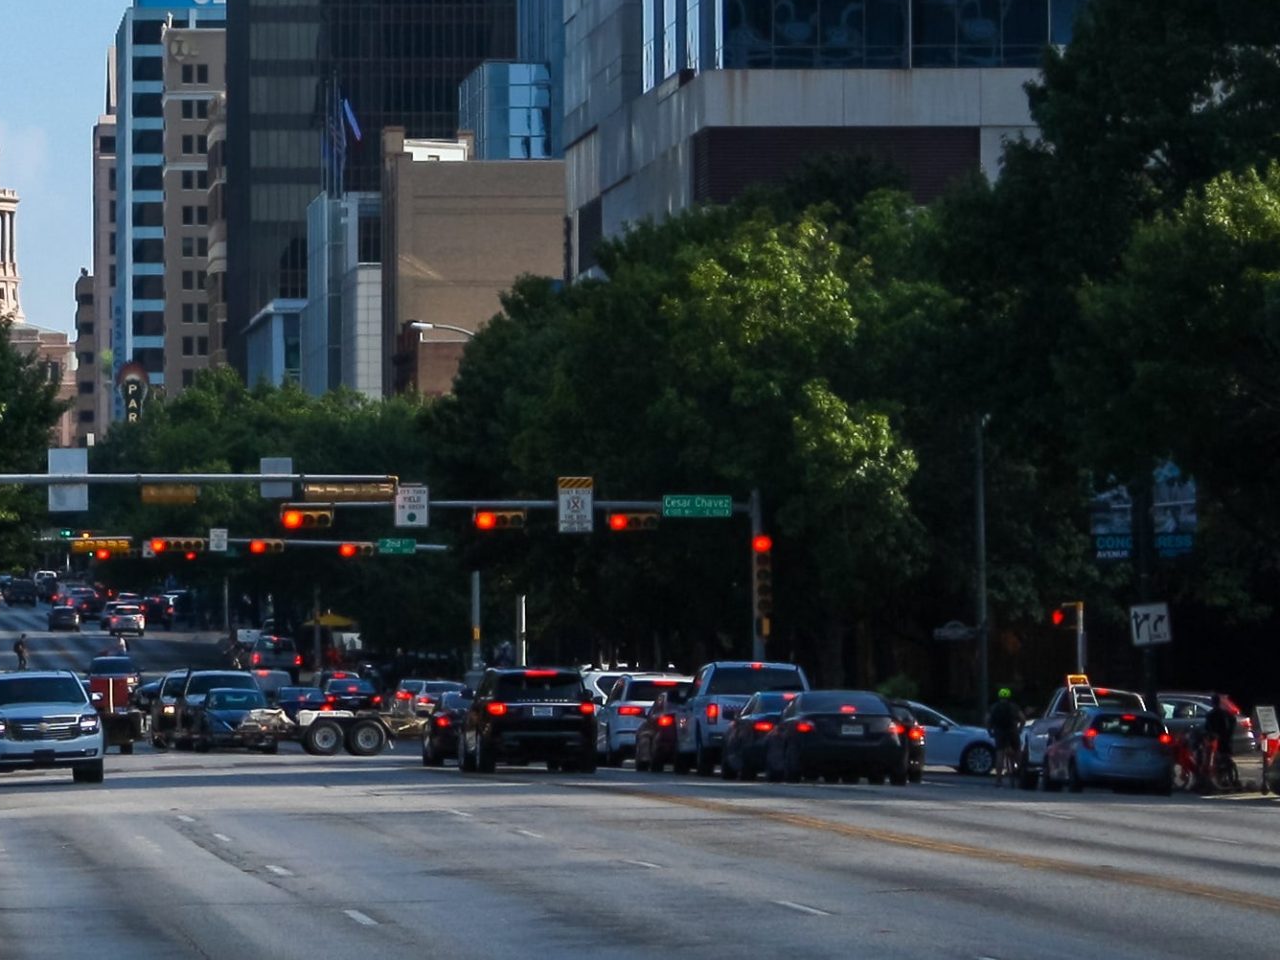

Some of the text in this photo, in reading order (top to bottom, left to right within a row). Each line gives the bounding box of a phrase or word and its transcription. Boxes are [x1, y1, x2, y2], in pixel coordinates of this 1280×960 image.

[128, 383, 139, 424] PAR
[665, 496, 729, 508] Cesar Chavez
